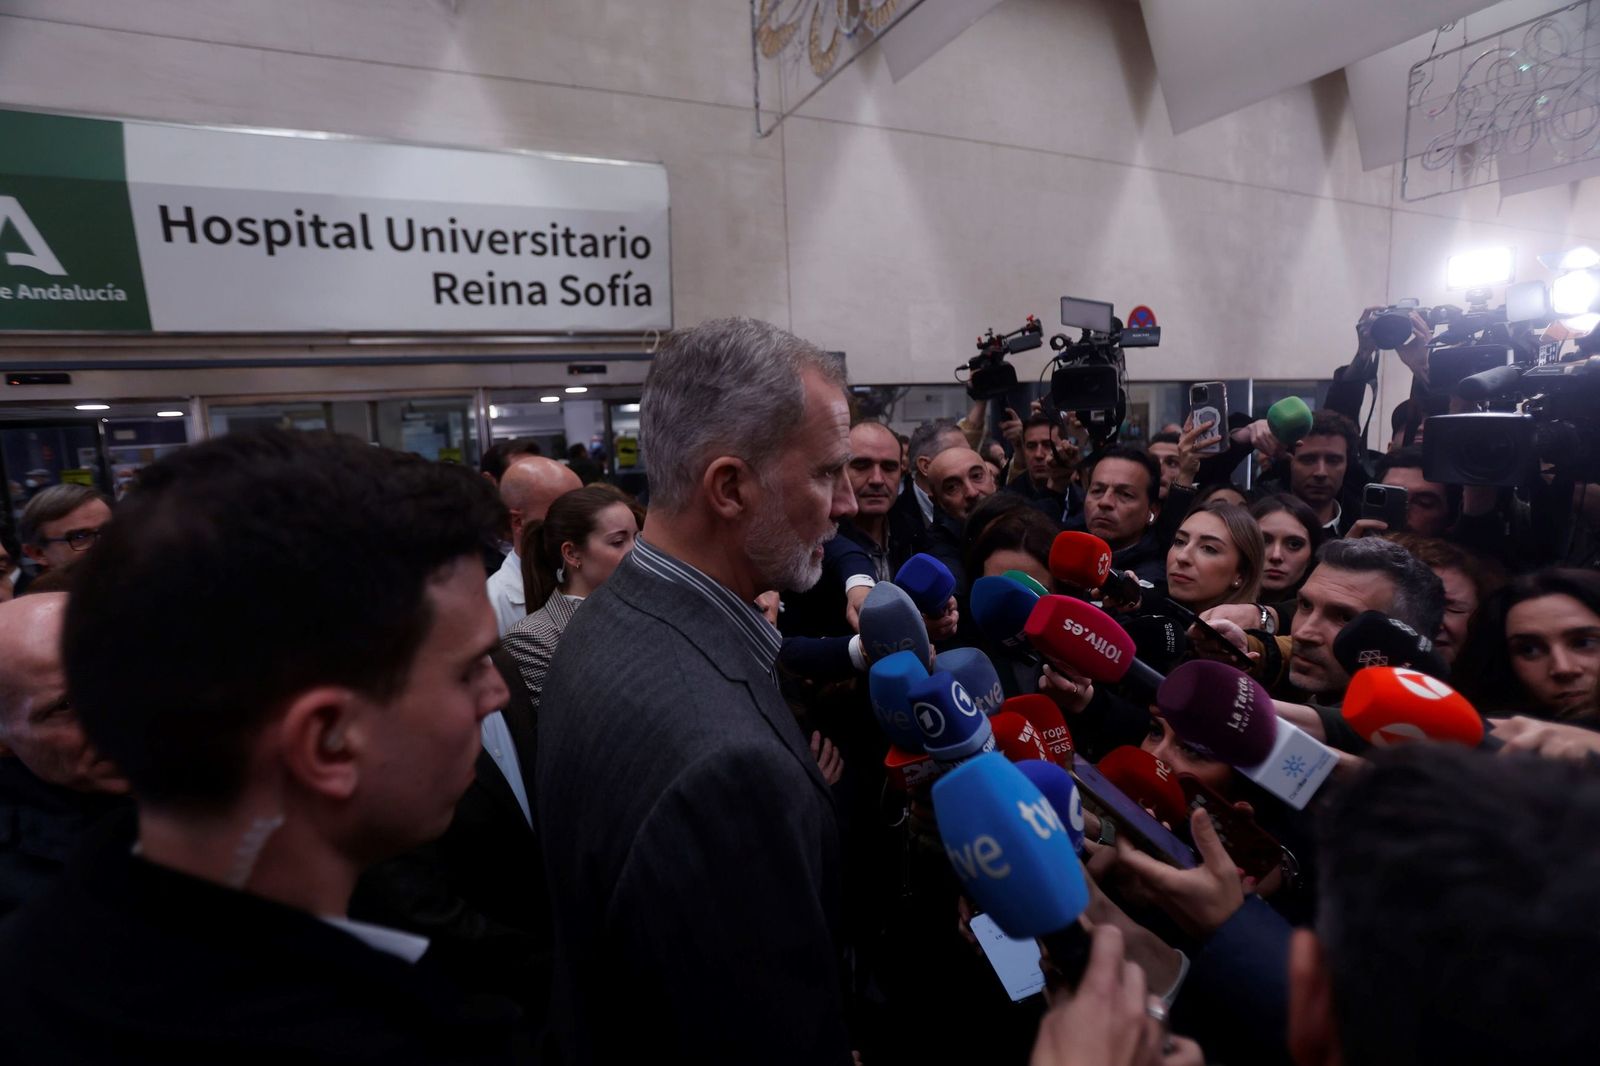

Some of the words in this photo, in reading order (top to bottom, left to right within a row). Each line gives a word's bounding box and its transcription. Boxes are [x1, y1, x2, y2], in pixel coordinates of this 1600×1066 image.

[158, 204, 373, 256] Hospital
[386, 216, 651, 259] Universitario
[0, 286, 14, 300] e
[16, 282, 128, 301] Andalucía
[432, 270, 547, 305] Reina
[560, 270, 652, 306] Sofía
[1062, 618, 1123, 664] 101tv.es
[1226, 710, 1243, 730] La
[1042, 725, 1067, 740] ropa
[1049, 741, 1071, 754] ress
